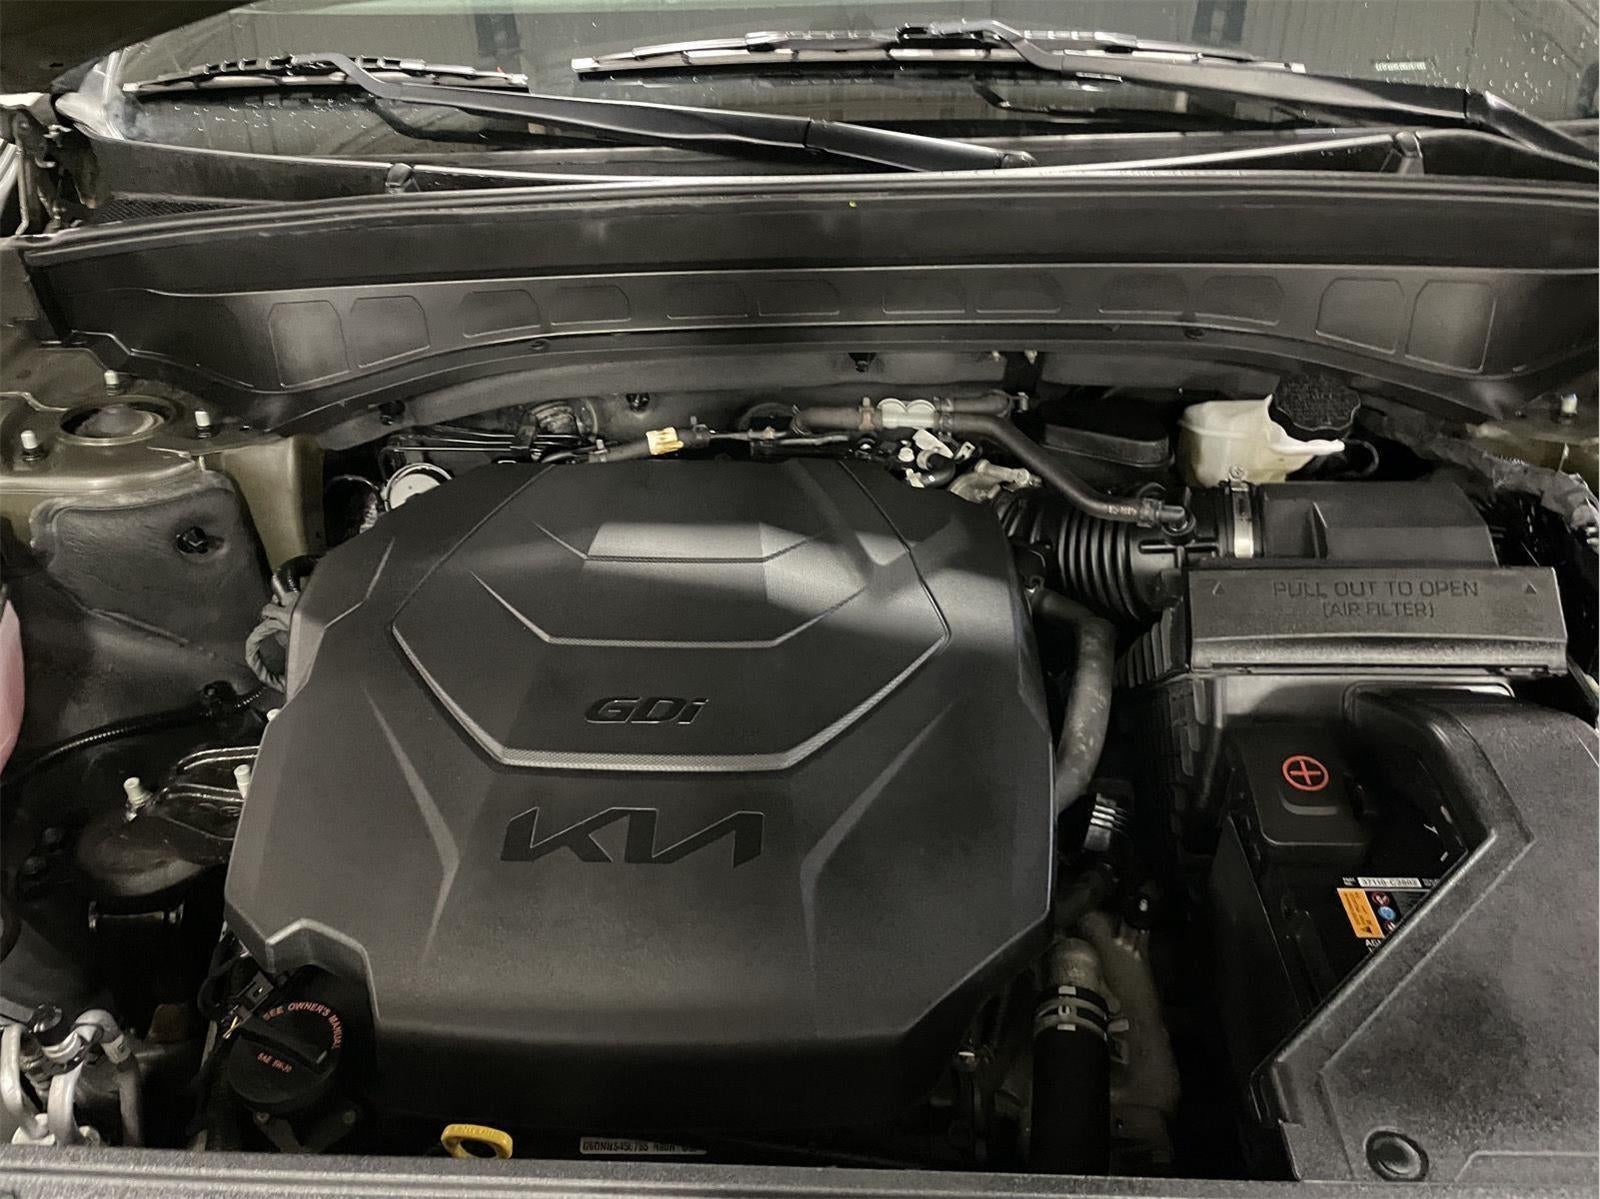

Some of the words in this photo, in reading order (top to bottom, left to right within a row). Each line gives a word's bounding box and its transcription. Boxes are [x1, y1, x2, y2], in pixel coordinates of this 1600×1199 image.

[1272, 581, 1327, 598] PULL
[1334, 581, 1379, 597] OUT
[1387, 580, 1414, 597] TO
[1419, 580, 1479, 597] OPEN
[584, 696, 710, 725] GDi
[500, 806, 765, 869] KIA
[262, 1005, 285, 1021] SEE
[287, 1001, 331, 1017] OWNER'S
[328, 1014, 344, 1050] MANUAL
